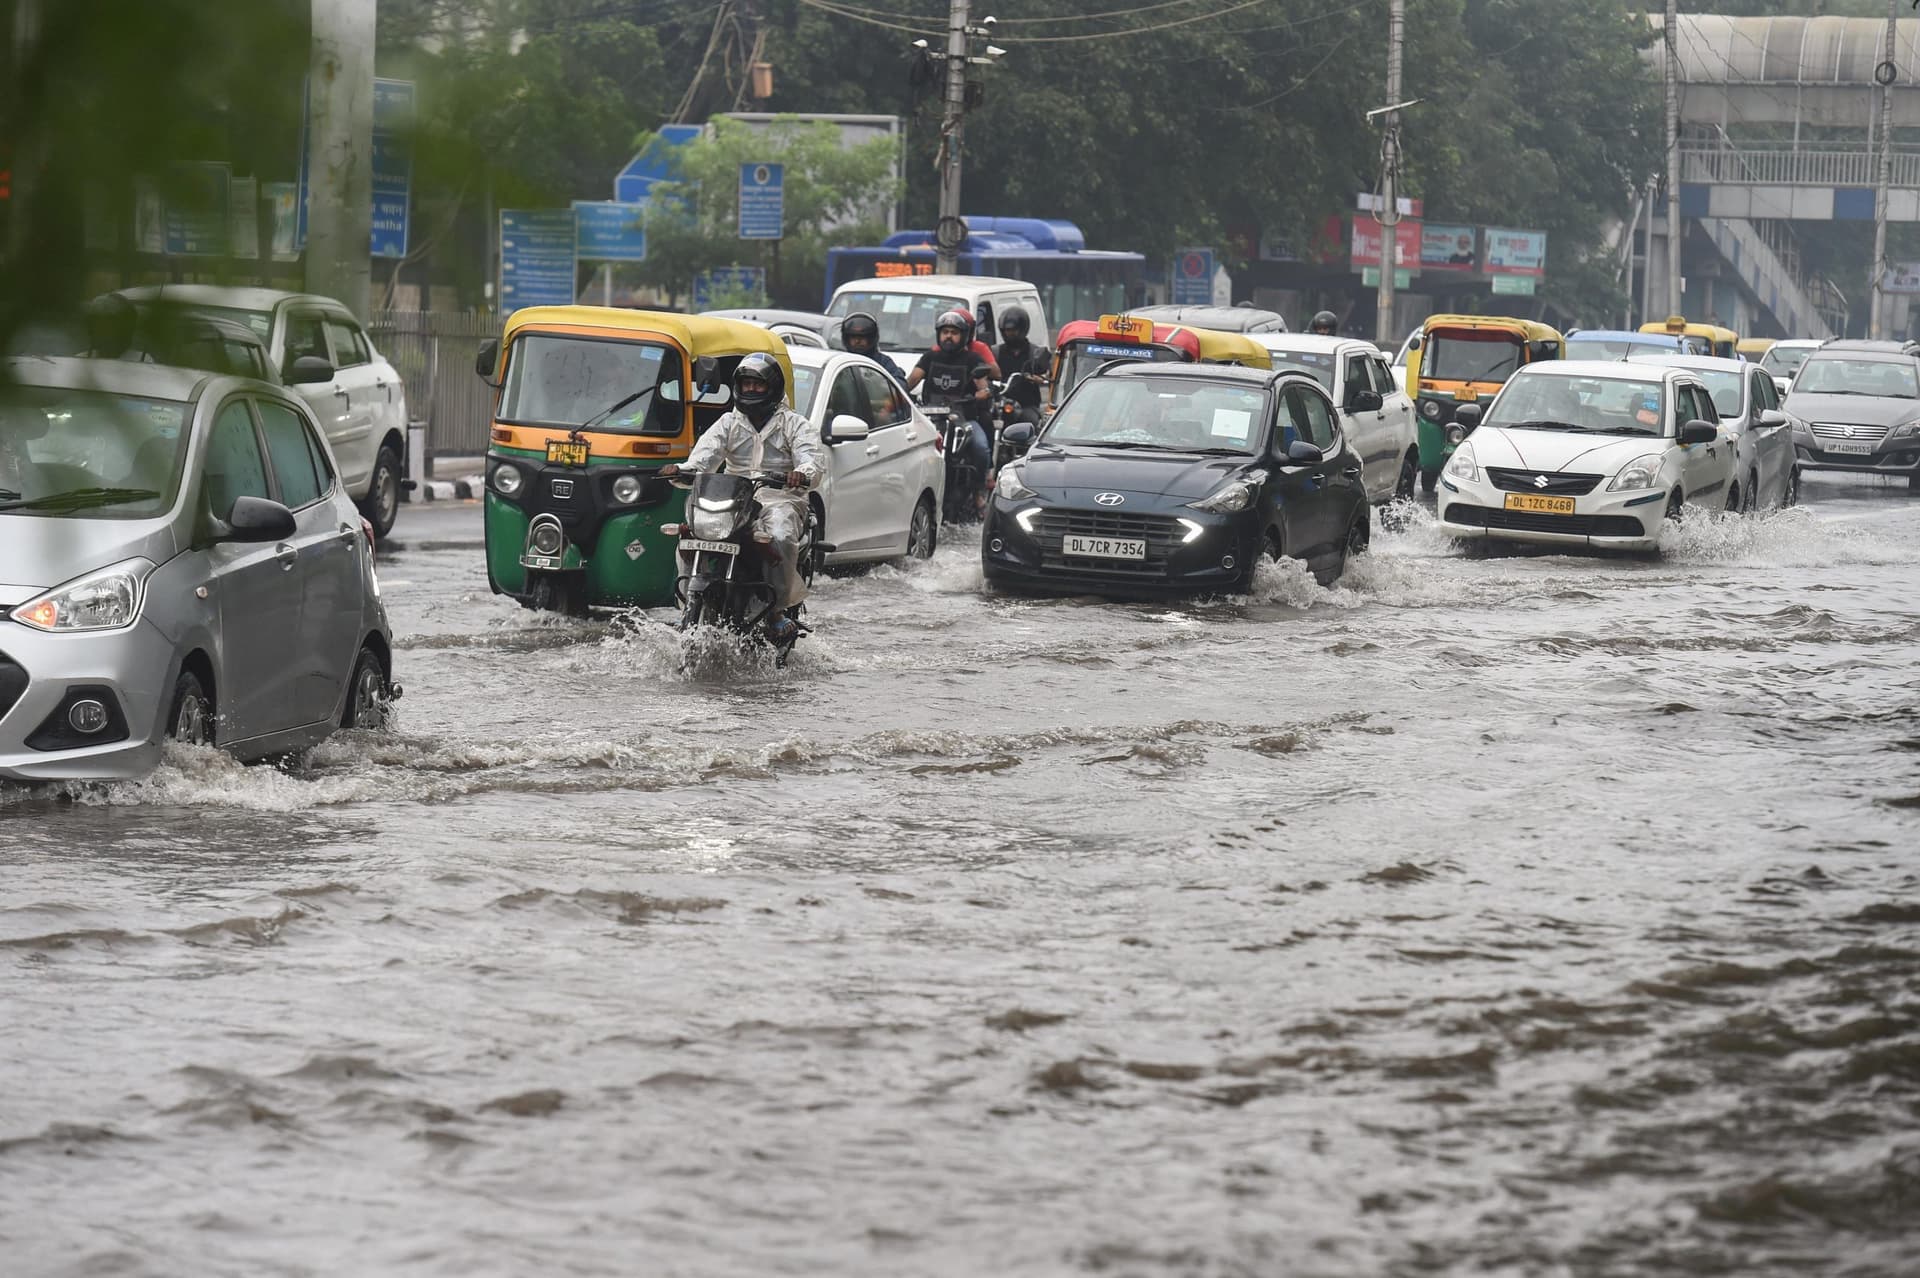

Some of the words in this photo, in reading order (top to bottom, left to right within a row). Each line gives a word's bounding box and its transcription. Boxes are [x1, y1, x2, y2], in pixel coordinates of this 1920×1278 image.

[555, 485, 569, 495] RE
[1513, 497, 1525, 508] DL
[1529, 498, 1545, 509] 1ZC
[1547, 499, 1572, 511] 8468
[1072, 539, 1086, 552] DL
[1089, 540, 1110, 554] 7CR
[1114, 542, 1144, 556] 7354
